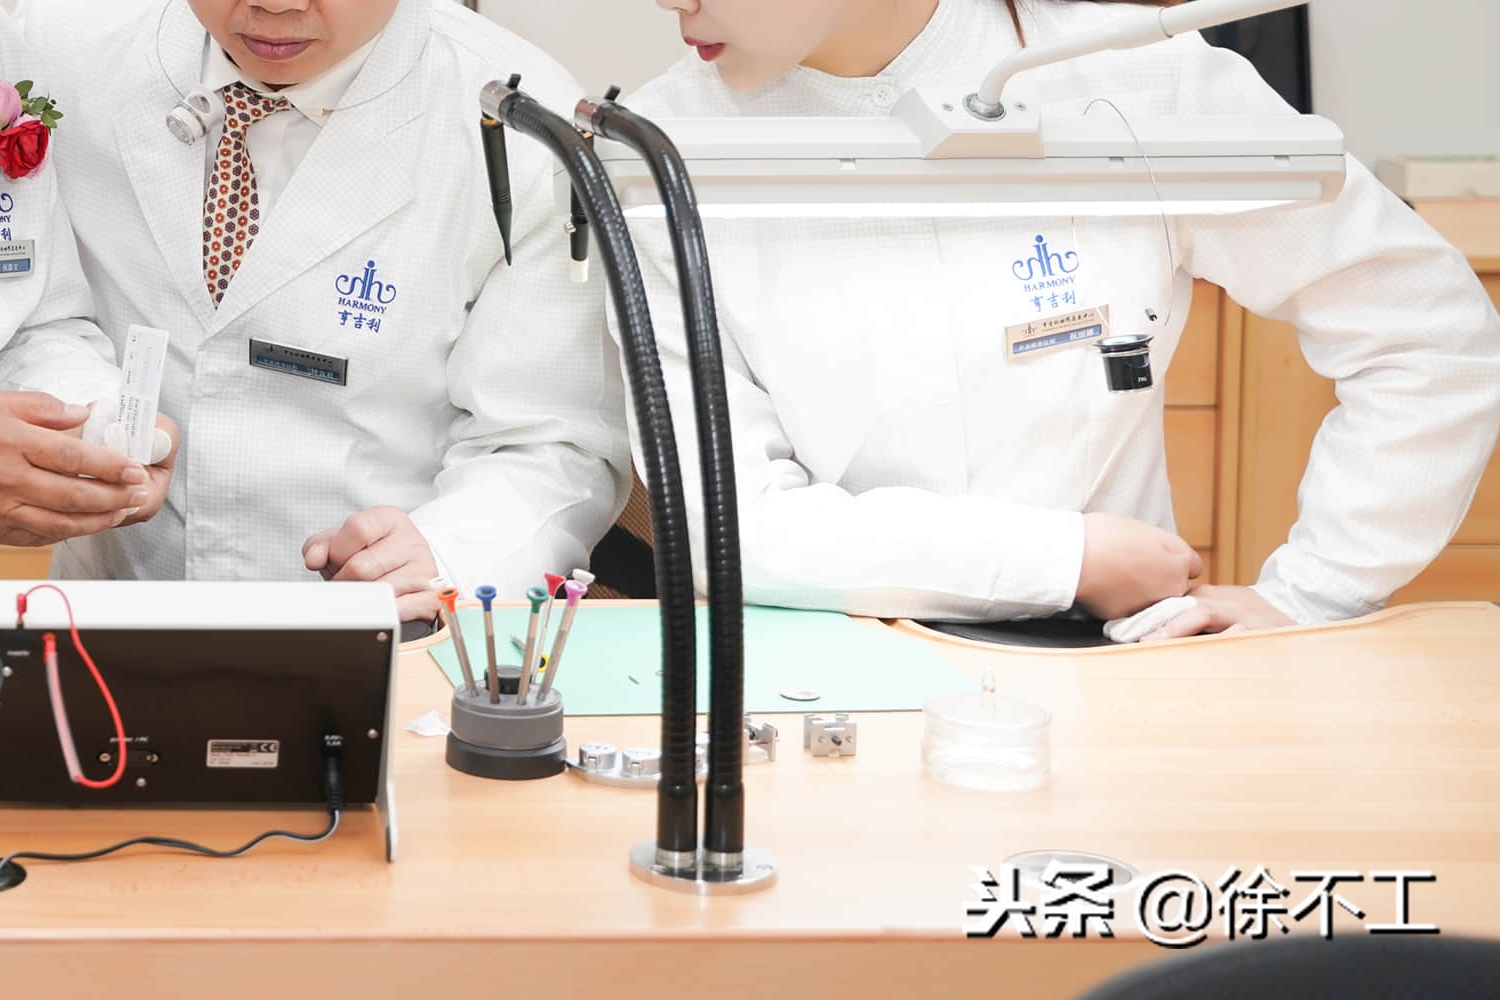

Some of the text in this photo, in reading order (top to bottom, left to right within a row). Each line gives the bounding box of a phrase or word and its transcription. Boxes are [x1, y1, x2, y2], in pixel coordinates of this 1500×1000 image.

[1023, 276, 1076, 292] HARMONY
[338, 297, 387, 314] HARMONY
[1030, 290, 1076, 312] 亨吉利
[338, 310, 381, 333] 亨吉利
